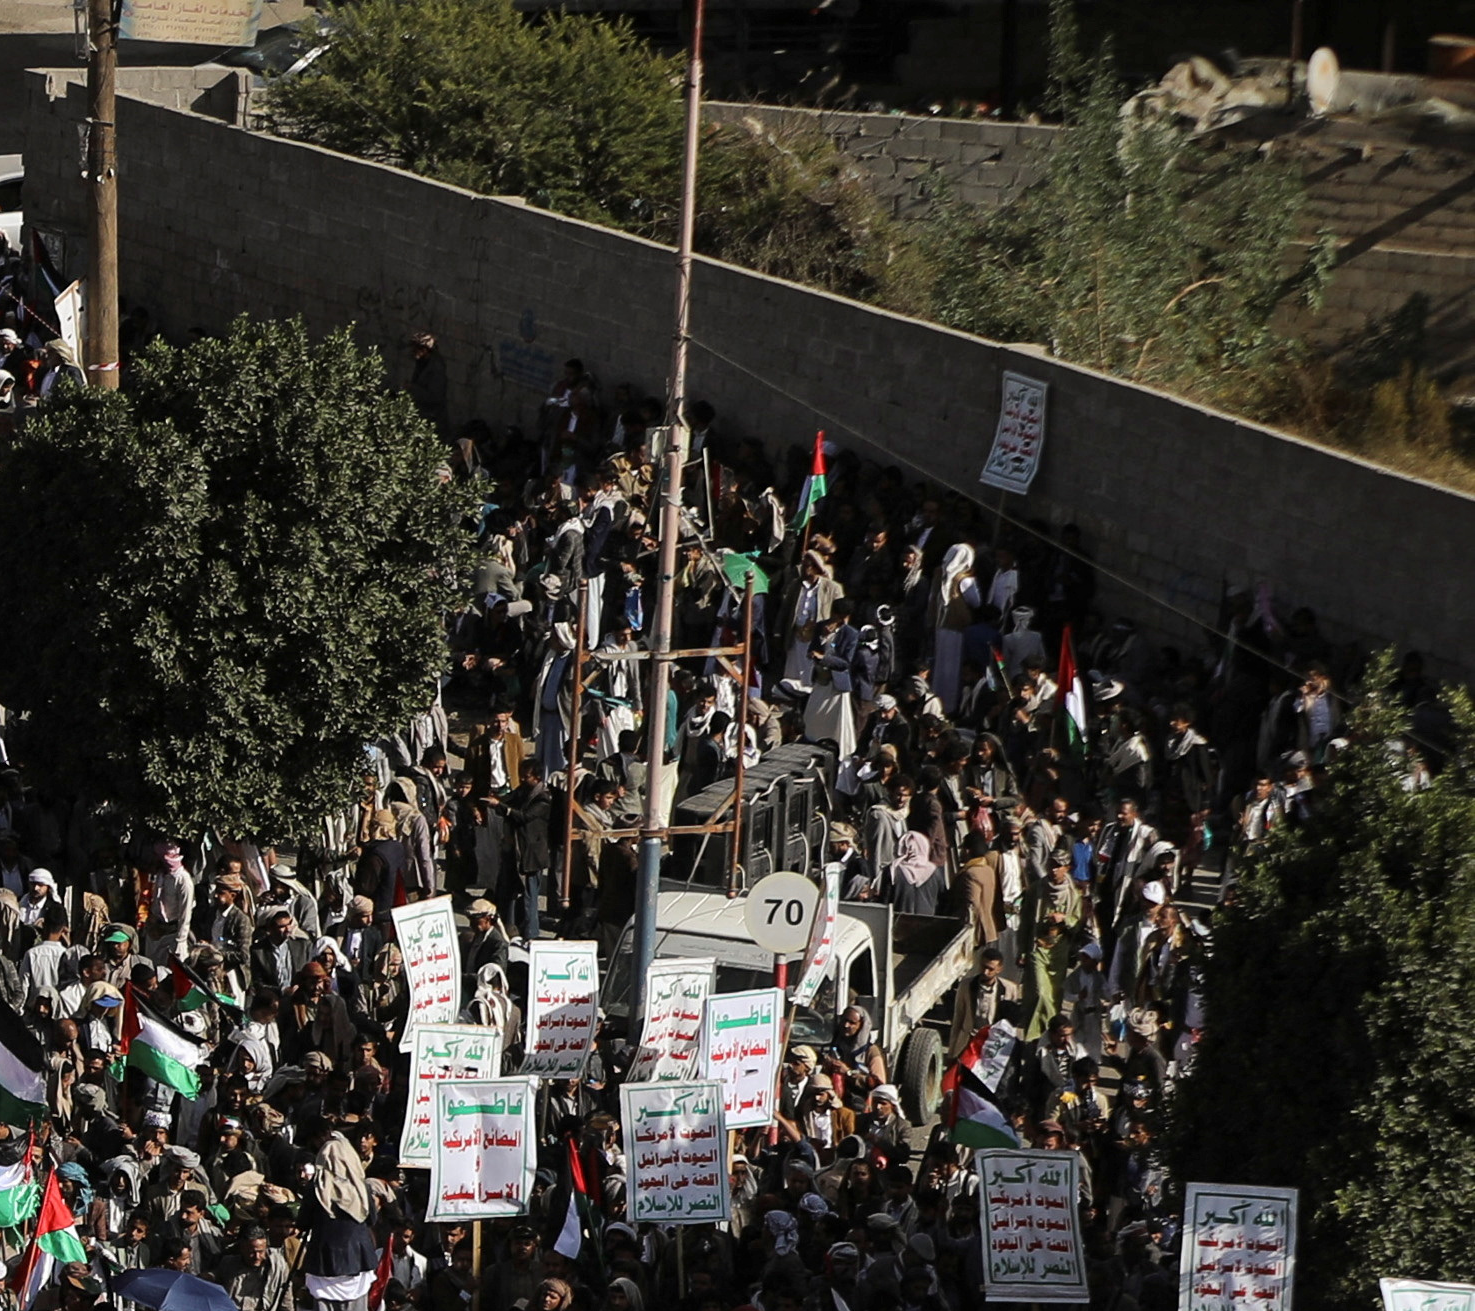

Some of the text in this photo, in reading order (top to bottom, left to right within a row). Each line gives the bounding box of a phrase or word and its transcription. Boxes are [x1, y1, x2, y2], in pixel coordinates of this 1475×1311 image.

[764, 899, 804, 926] 70
[443, 1092, 523, 1122] قاطعوا
[636, 1091, 714, 1124] الله أكبر
[443, 1125, 521, 1152] البضائع الأمريكية
[679, 1126, 715, 1141] الموت
[682, 1149, 717, 1165] الموت
[637, 1174, 668, 1189] اليهود
[691, 1172, 718, 1186] اللعنة
[442, 1181, 519, 1204] الإسرائيلية
[685, 1194, 721, 1213] النصر
